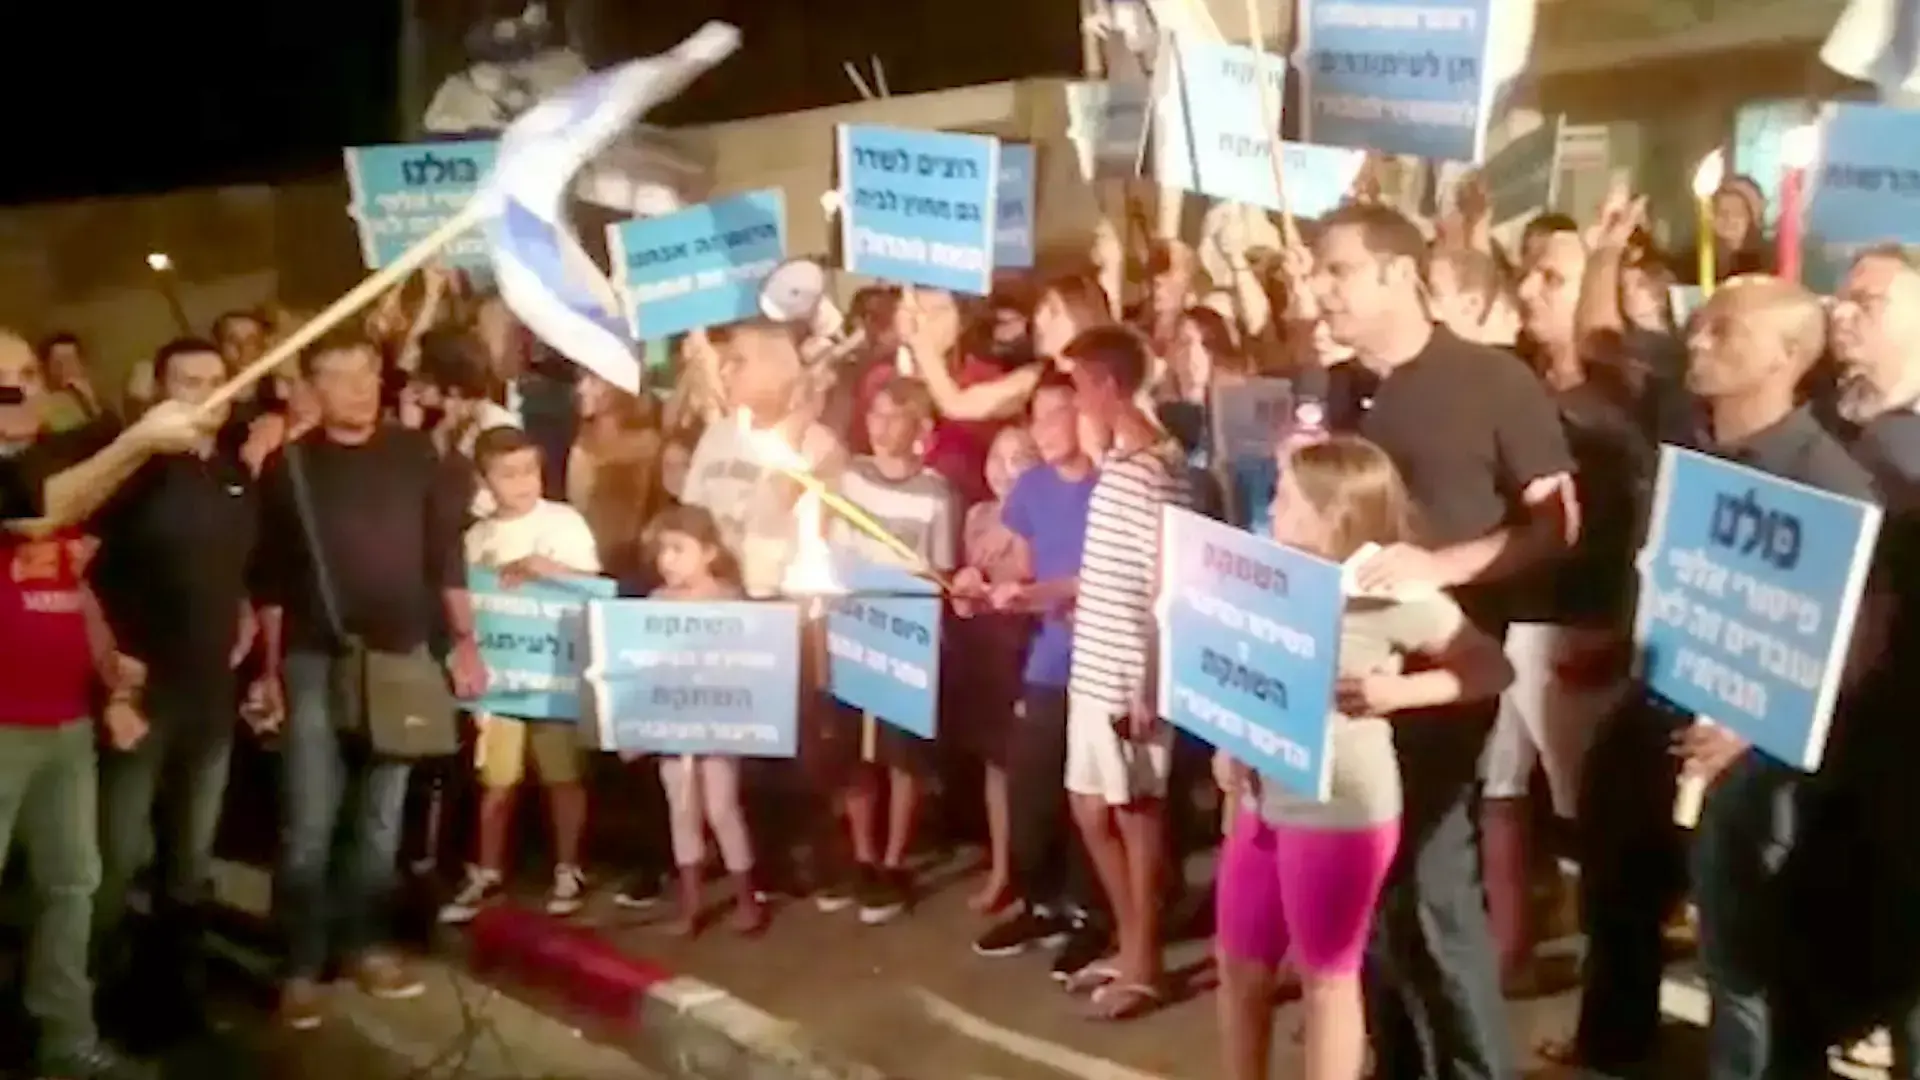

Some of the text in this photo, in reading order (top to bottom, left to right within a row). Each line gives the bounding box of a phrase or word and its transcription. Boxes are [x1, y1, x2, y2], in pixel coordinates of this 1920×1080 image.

[403, 152, 478, 185] כולנו
[853, 147, 909, 173] לשדר
[917, 154, 979, 180] רוצים
[1710, 488, 1804, 570] כולנו
